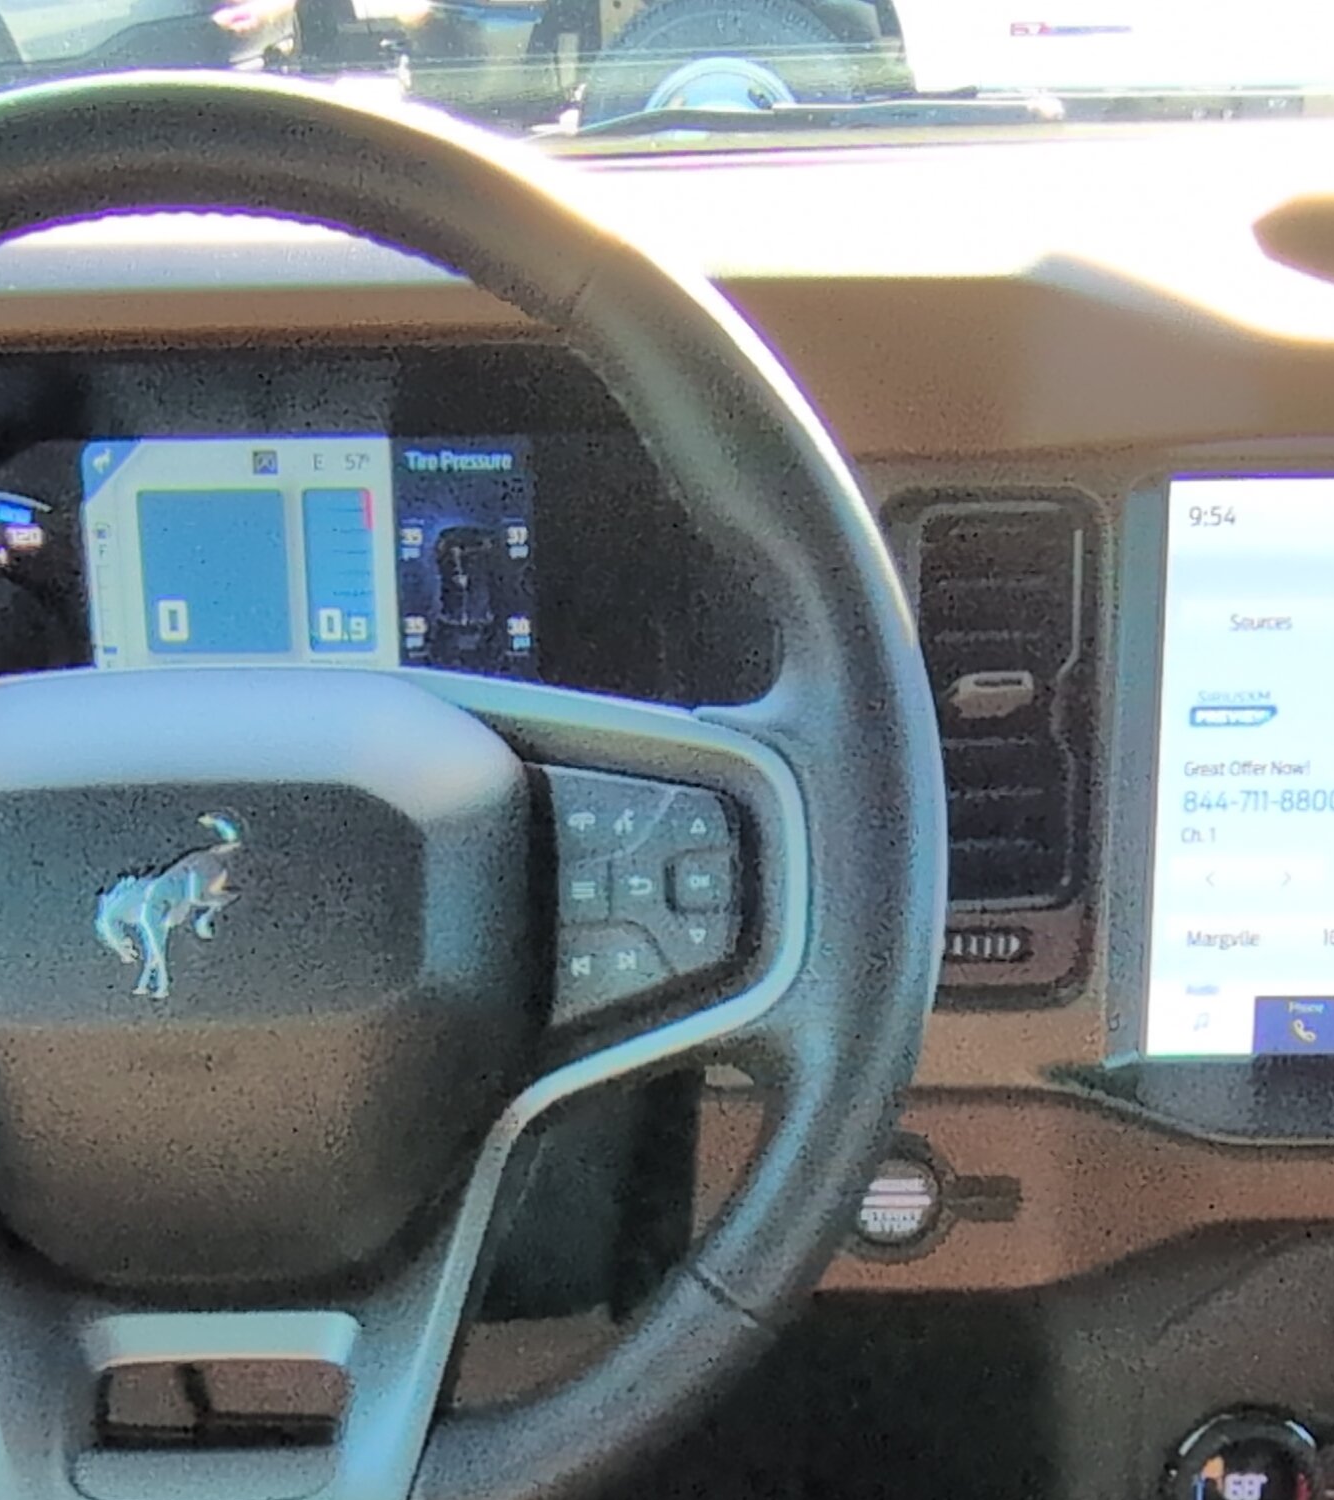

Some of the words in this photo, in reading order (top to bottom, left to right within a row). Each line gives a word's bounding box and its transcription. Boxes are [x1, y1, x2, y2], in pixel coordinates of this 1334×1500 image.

[404, 451, 436, 470] Tire
[439, 452, 513, 473] Pressure
[1188, 505, 1237, 528] 9:54
[157, 599, 190, 642] 0
[1229, 613, 1293, 632] Sources
[1183, 760, 1227, 777] Great
[1229, 760, 1268, 777] Offer
[1270, 759, 1311, 776] Now!
[1180, 827, 1206, 844] Ch.
[1209, 827, 1217, 843] 1
